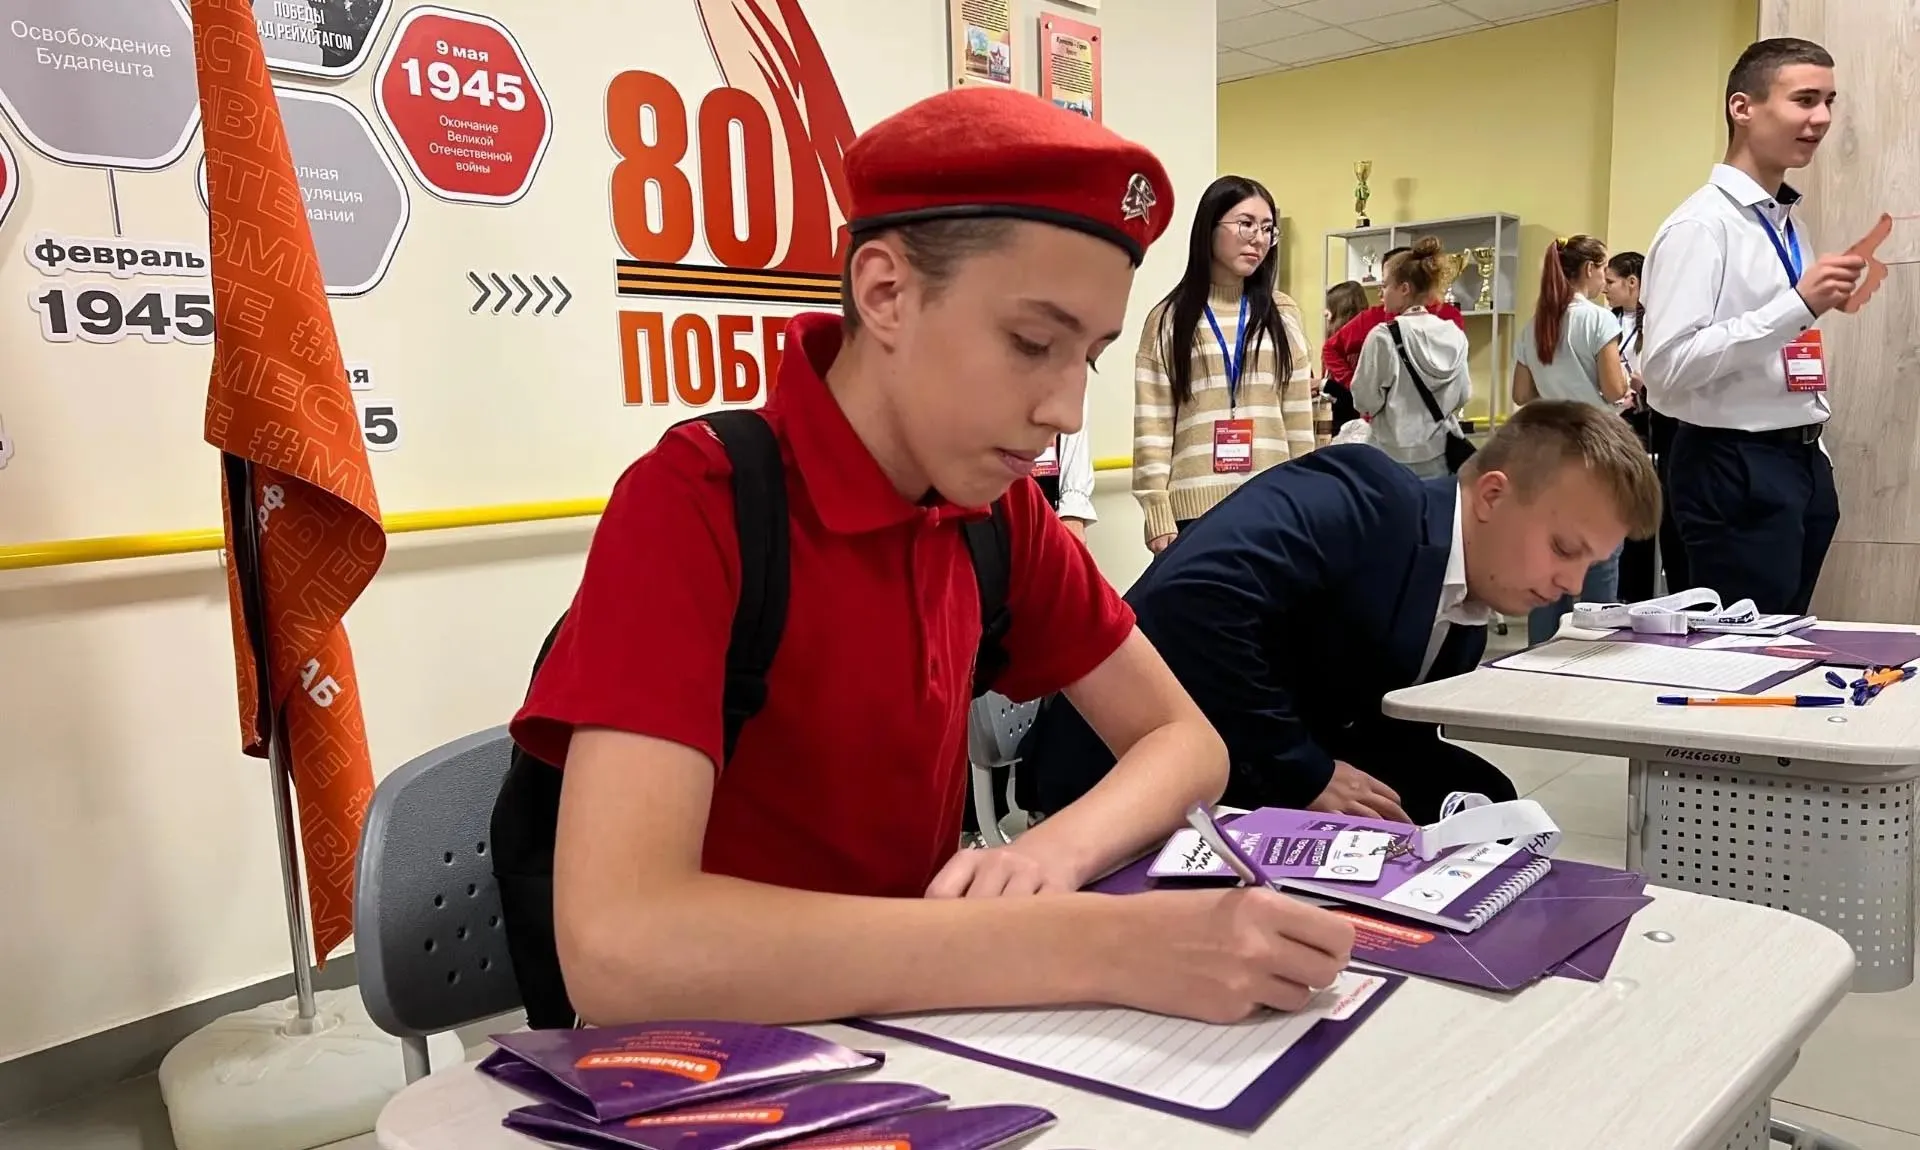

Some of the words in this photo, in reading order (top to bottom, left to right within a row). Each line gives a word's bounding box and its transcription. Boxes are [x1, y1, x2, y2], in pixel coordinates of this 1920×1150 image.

[274, 2, 325, 25] ПОБЕДЫ
[11, 20, 171, 58] Освобождение
[256, 19, 276, 39] АД
[277, 22, 353, 50] РЕЙХСТАГОМ
[36, 47, 154, 78] Будапешта
[435, 40, 449, 55] 9
[452, 46, 489, 62] мая
[401, 57, 526, 111] 1945
[439, 115, 499, 133] Окончание
[447, 130, 494, 146] Великой
[429, 142, 513, 163] Отечественной
[456, 161, 490, 173] войны
[606, 69, 778, 268] 80
[300, 187, 363, 203] уляция
[35, 239, 204, 270] февраль
[39, 289, 214, 337] 1945
